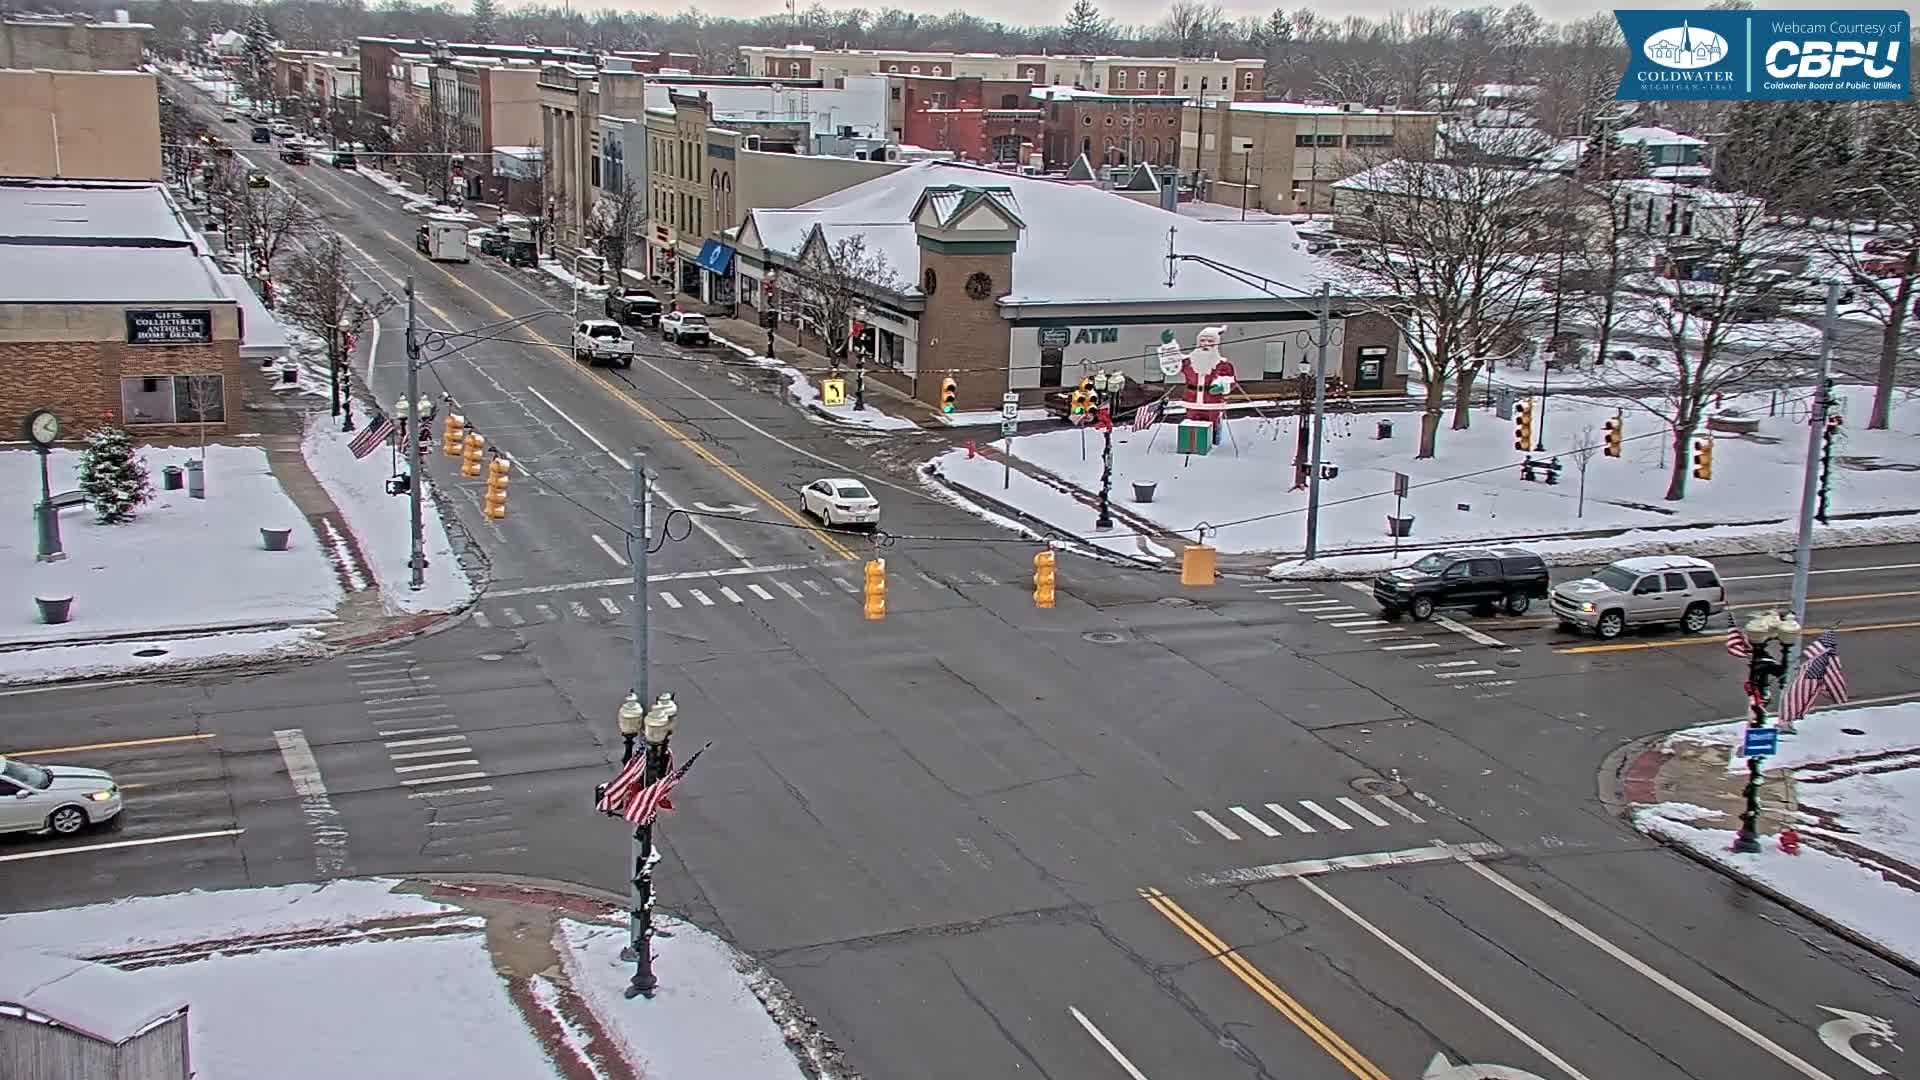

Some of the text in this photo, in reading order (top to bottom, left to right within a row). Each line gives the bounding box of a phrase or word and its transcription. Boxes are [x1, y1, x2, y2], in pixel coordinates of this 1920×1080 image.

[138, 331, 166, 339] HOME
[1074, 327, 1119, 345] ATM
[1005, 404, 1016, 416] 12
